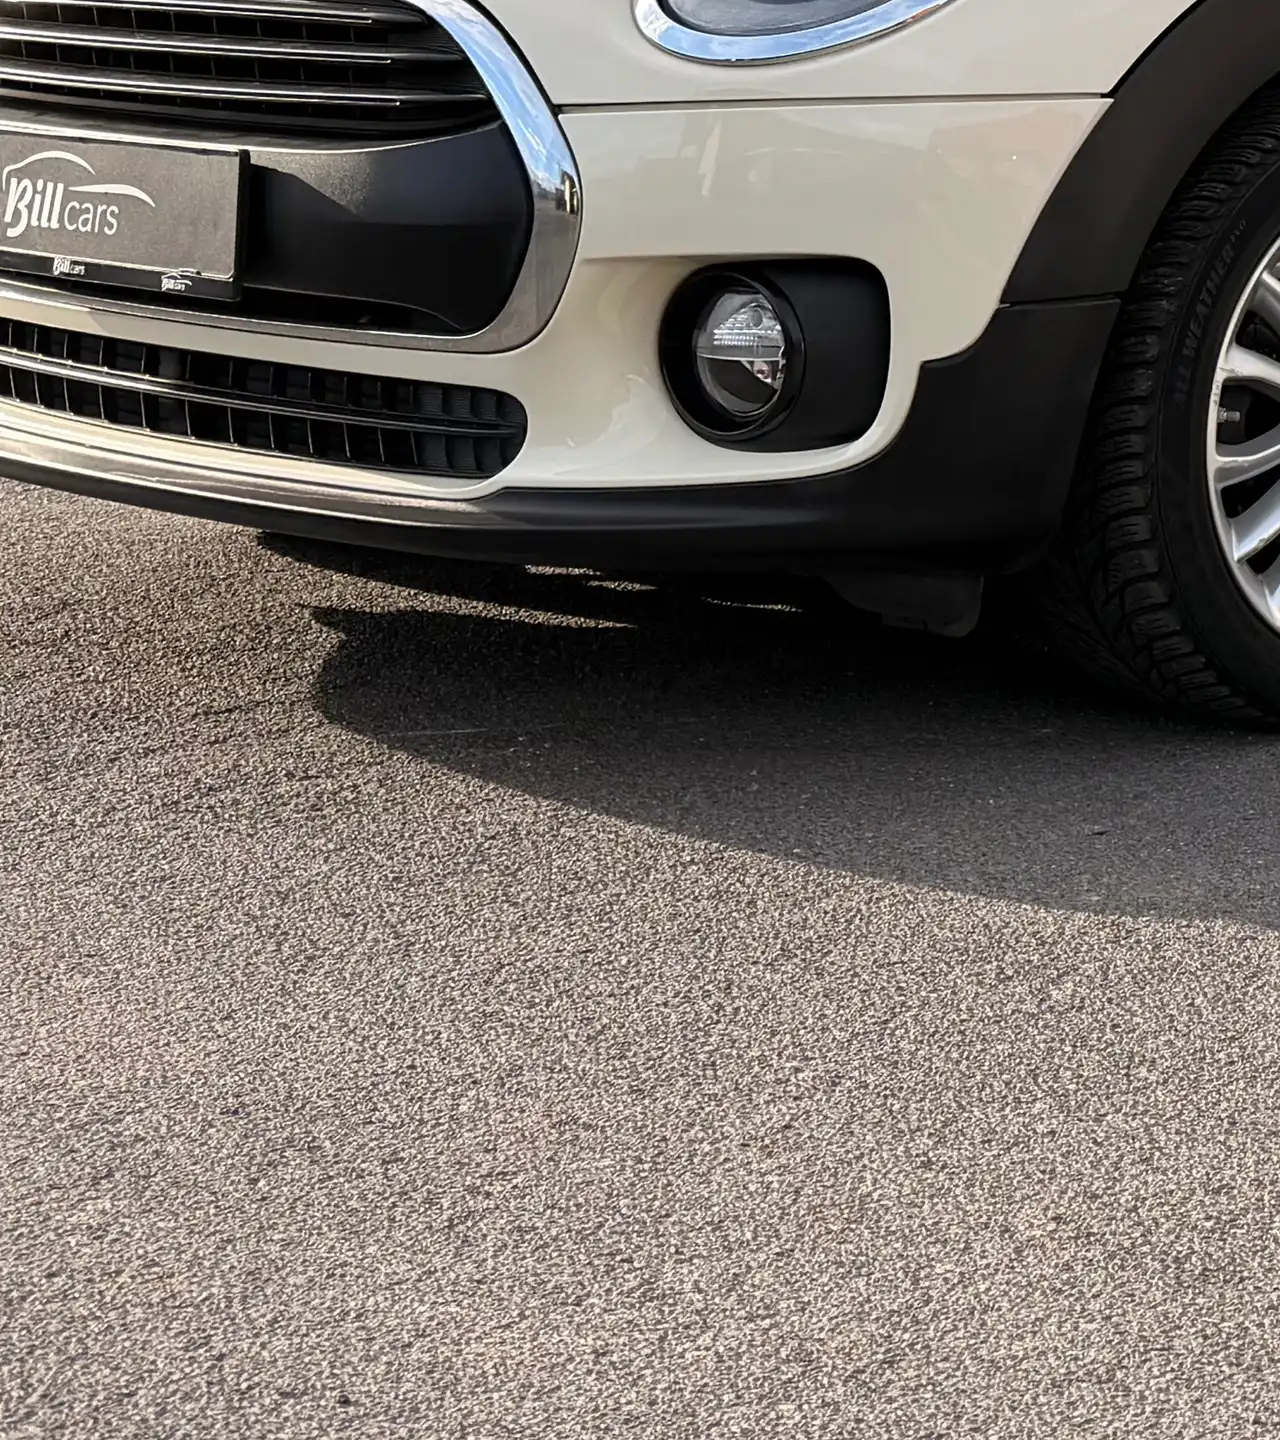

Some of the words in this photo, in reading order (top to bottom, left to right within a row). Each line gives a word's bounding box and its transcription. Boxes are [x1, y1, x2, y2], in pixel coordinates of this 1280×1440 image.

[4, 176, 65, 237] Bill
[64, 200, 119, 236] cars
[53, 256, 70, 276] Bill
[1182, 241, 1236, 358] WEATHER
